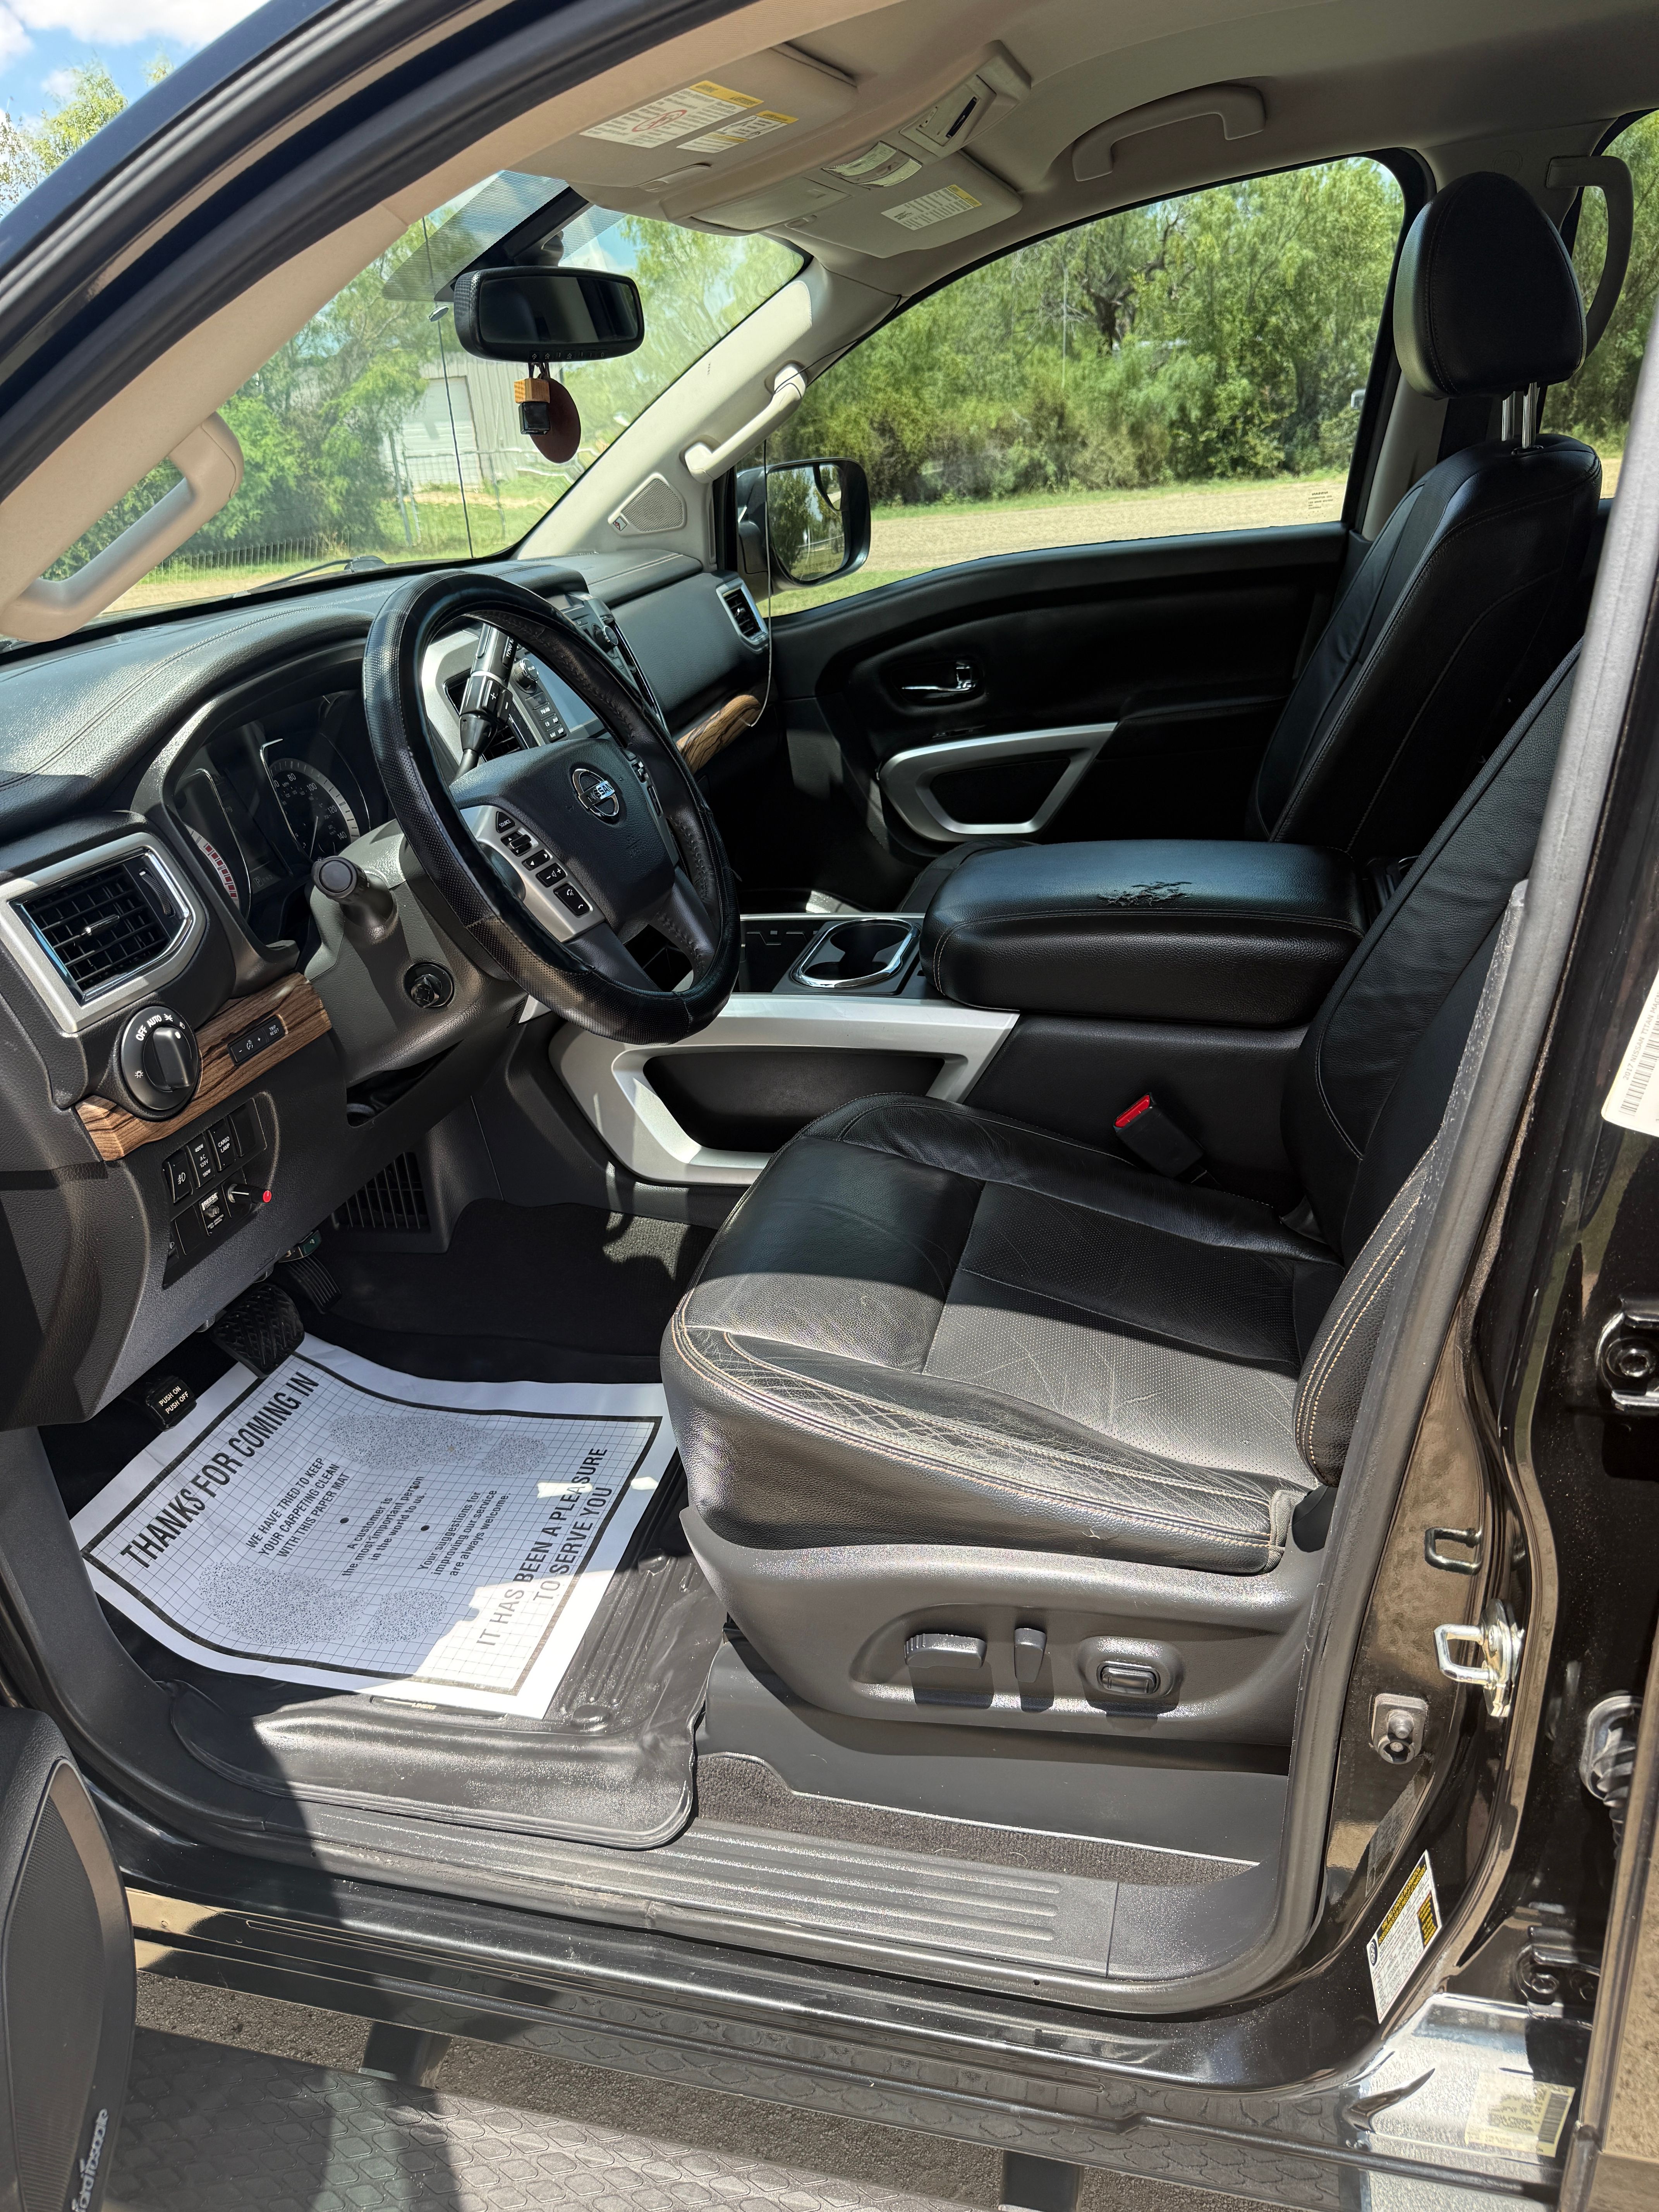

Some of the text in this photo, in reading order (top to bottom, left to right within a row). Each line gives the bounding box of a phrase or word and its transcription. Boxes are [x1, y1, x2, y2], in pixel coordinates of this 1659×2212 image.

[287, 773, 296, 781] 80
[306, 782, 317, 791] 100
[586, 784, 613, 802] NISSAN
[327, 805, 337, 814] 120
[337, 831, 347, 840] 140
[499, 819, 511, 828] SOURCE
[136, 1015, 162, 1041] OFF AUTO
[1623, 1063, 1633, 1080] 2017
[1630, 1037, 1644, 1063] NISSAN
[1641, 1015, 1654, 1035] TITAN
[218, 1136, 230, 1147] CARGO
[220, 1143, 230, 1153] LAMP
[200, 1159, 208, 1168] 120V
[203, 1168, 211, 1177] 150W
[203, 1192, 218, 1206] REESE
[159, 1386, 181, 1407] PUSH ON
[165, 1391, 189, 1414] PUSH OFF
[120, 1371, 319, 1568] THANKS FOR COMING IN
[246, 1457, 324, 1548] WE HAVE TRIED TO KEEP
[258, 1463, 340, 1555] YOUR CARPETING CLEAN
[277, 1472, 350, 1557] WITH THIS PAPER MAT
[342, 1476, 424, 1576] the most important person
[354, 1505, 386, 1542] customer
[383, 1497, 393, 1506] is
[376, 1537, 392, 1552] the
[388, 1514, 409, 1538] world
[407, 1503, 417, 1515] to
[417, 1491, 481, 1571] Your suggestions for
[431, 1490, 497, 1575] improving our service
[450, 1561, 465, 1576] are
[460, 1531, 485, 1559] always
[476, 1448, 608, 1646] IT HAS BEEN A PLEASURE
[533, 1487, 612, 1600] TO SERVE YOU
